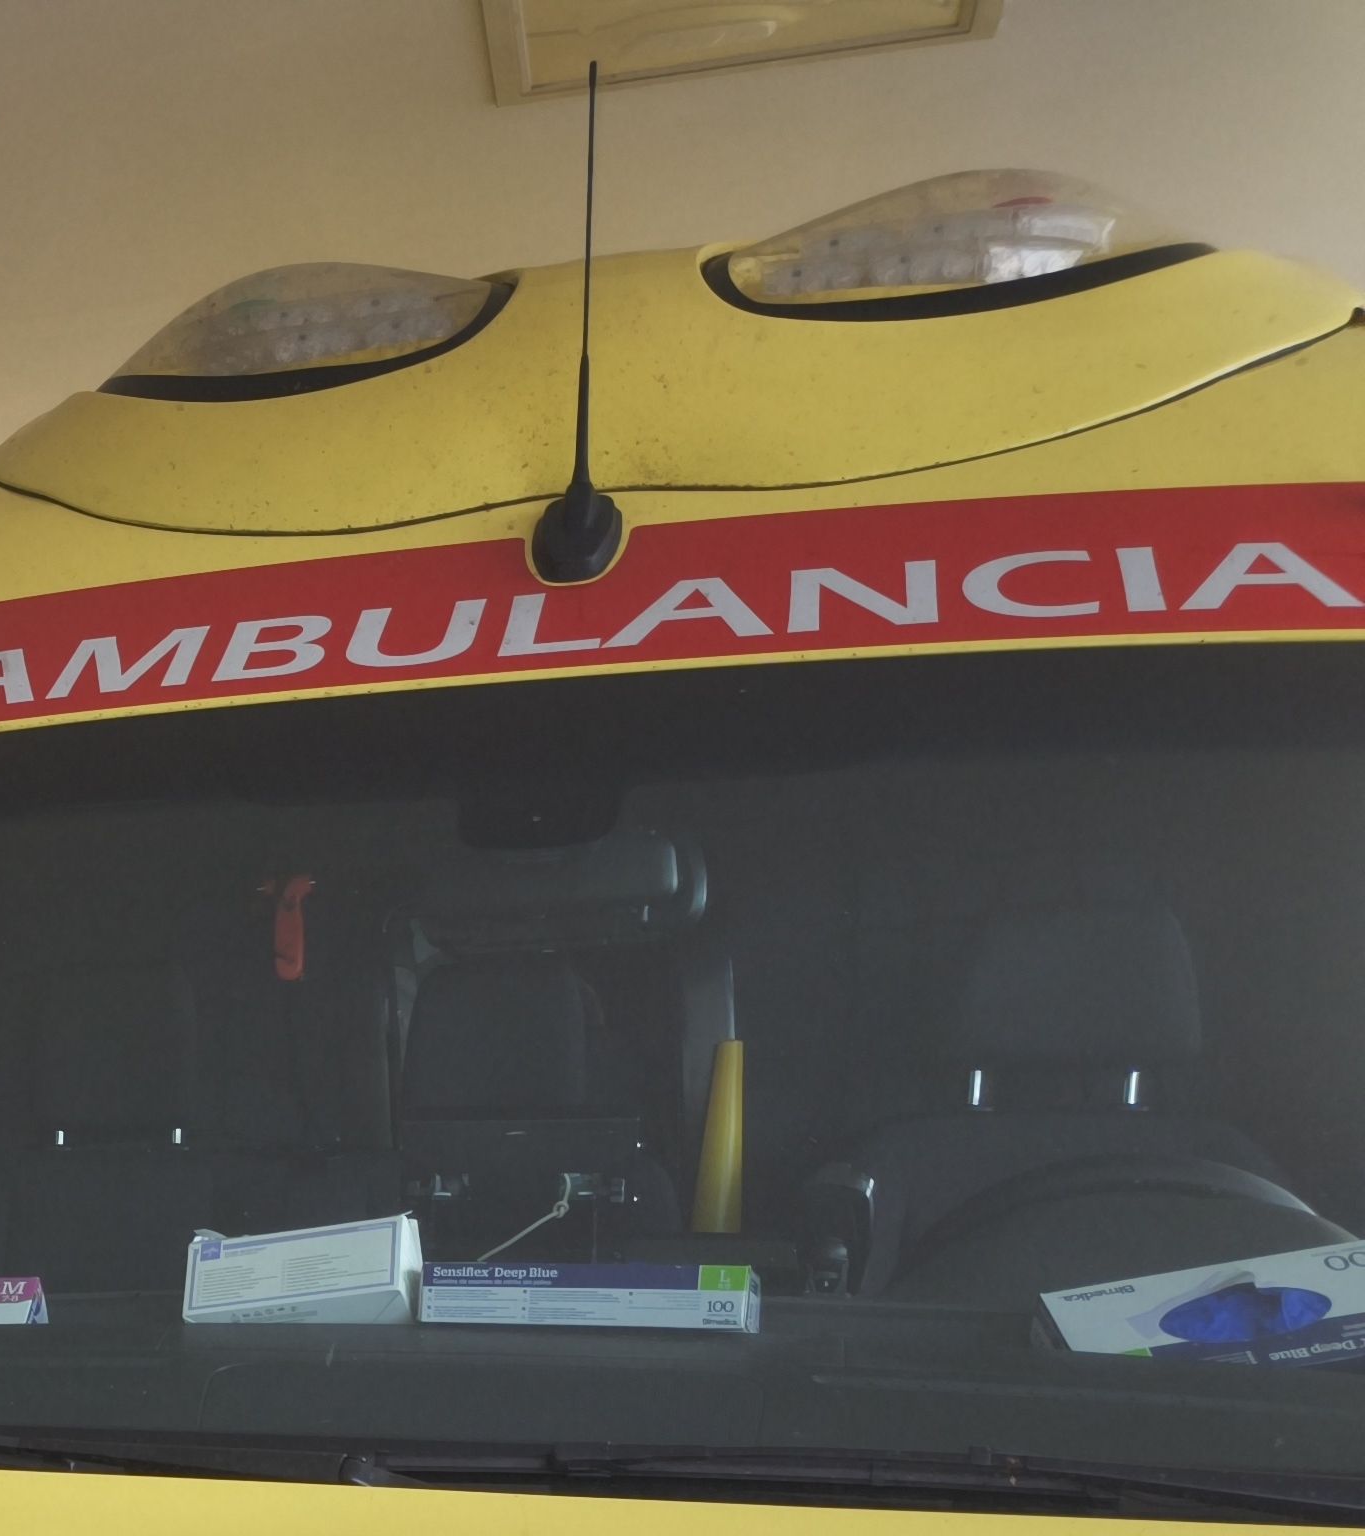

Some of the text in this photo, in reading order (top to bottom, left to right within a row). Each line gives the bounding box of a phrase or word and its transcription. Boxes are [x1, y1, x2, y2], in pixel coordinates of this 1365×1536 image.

[494, 1267, 526, 1280] Deep
[529, 1267, 558, 1278] Blue
[0, 1281, 28, 1295] M
[707, 1301, 735, 1312] 100
